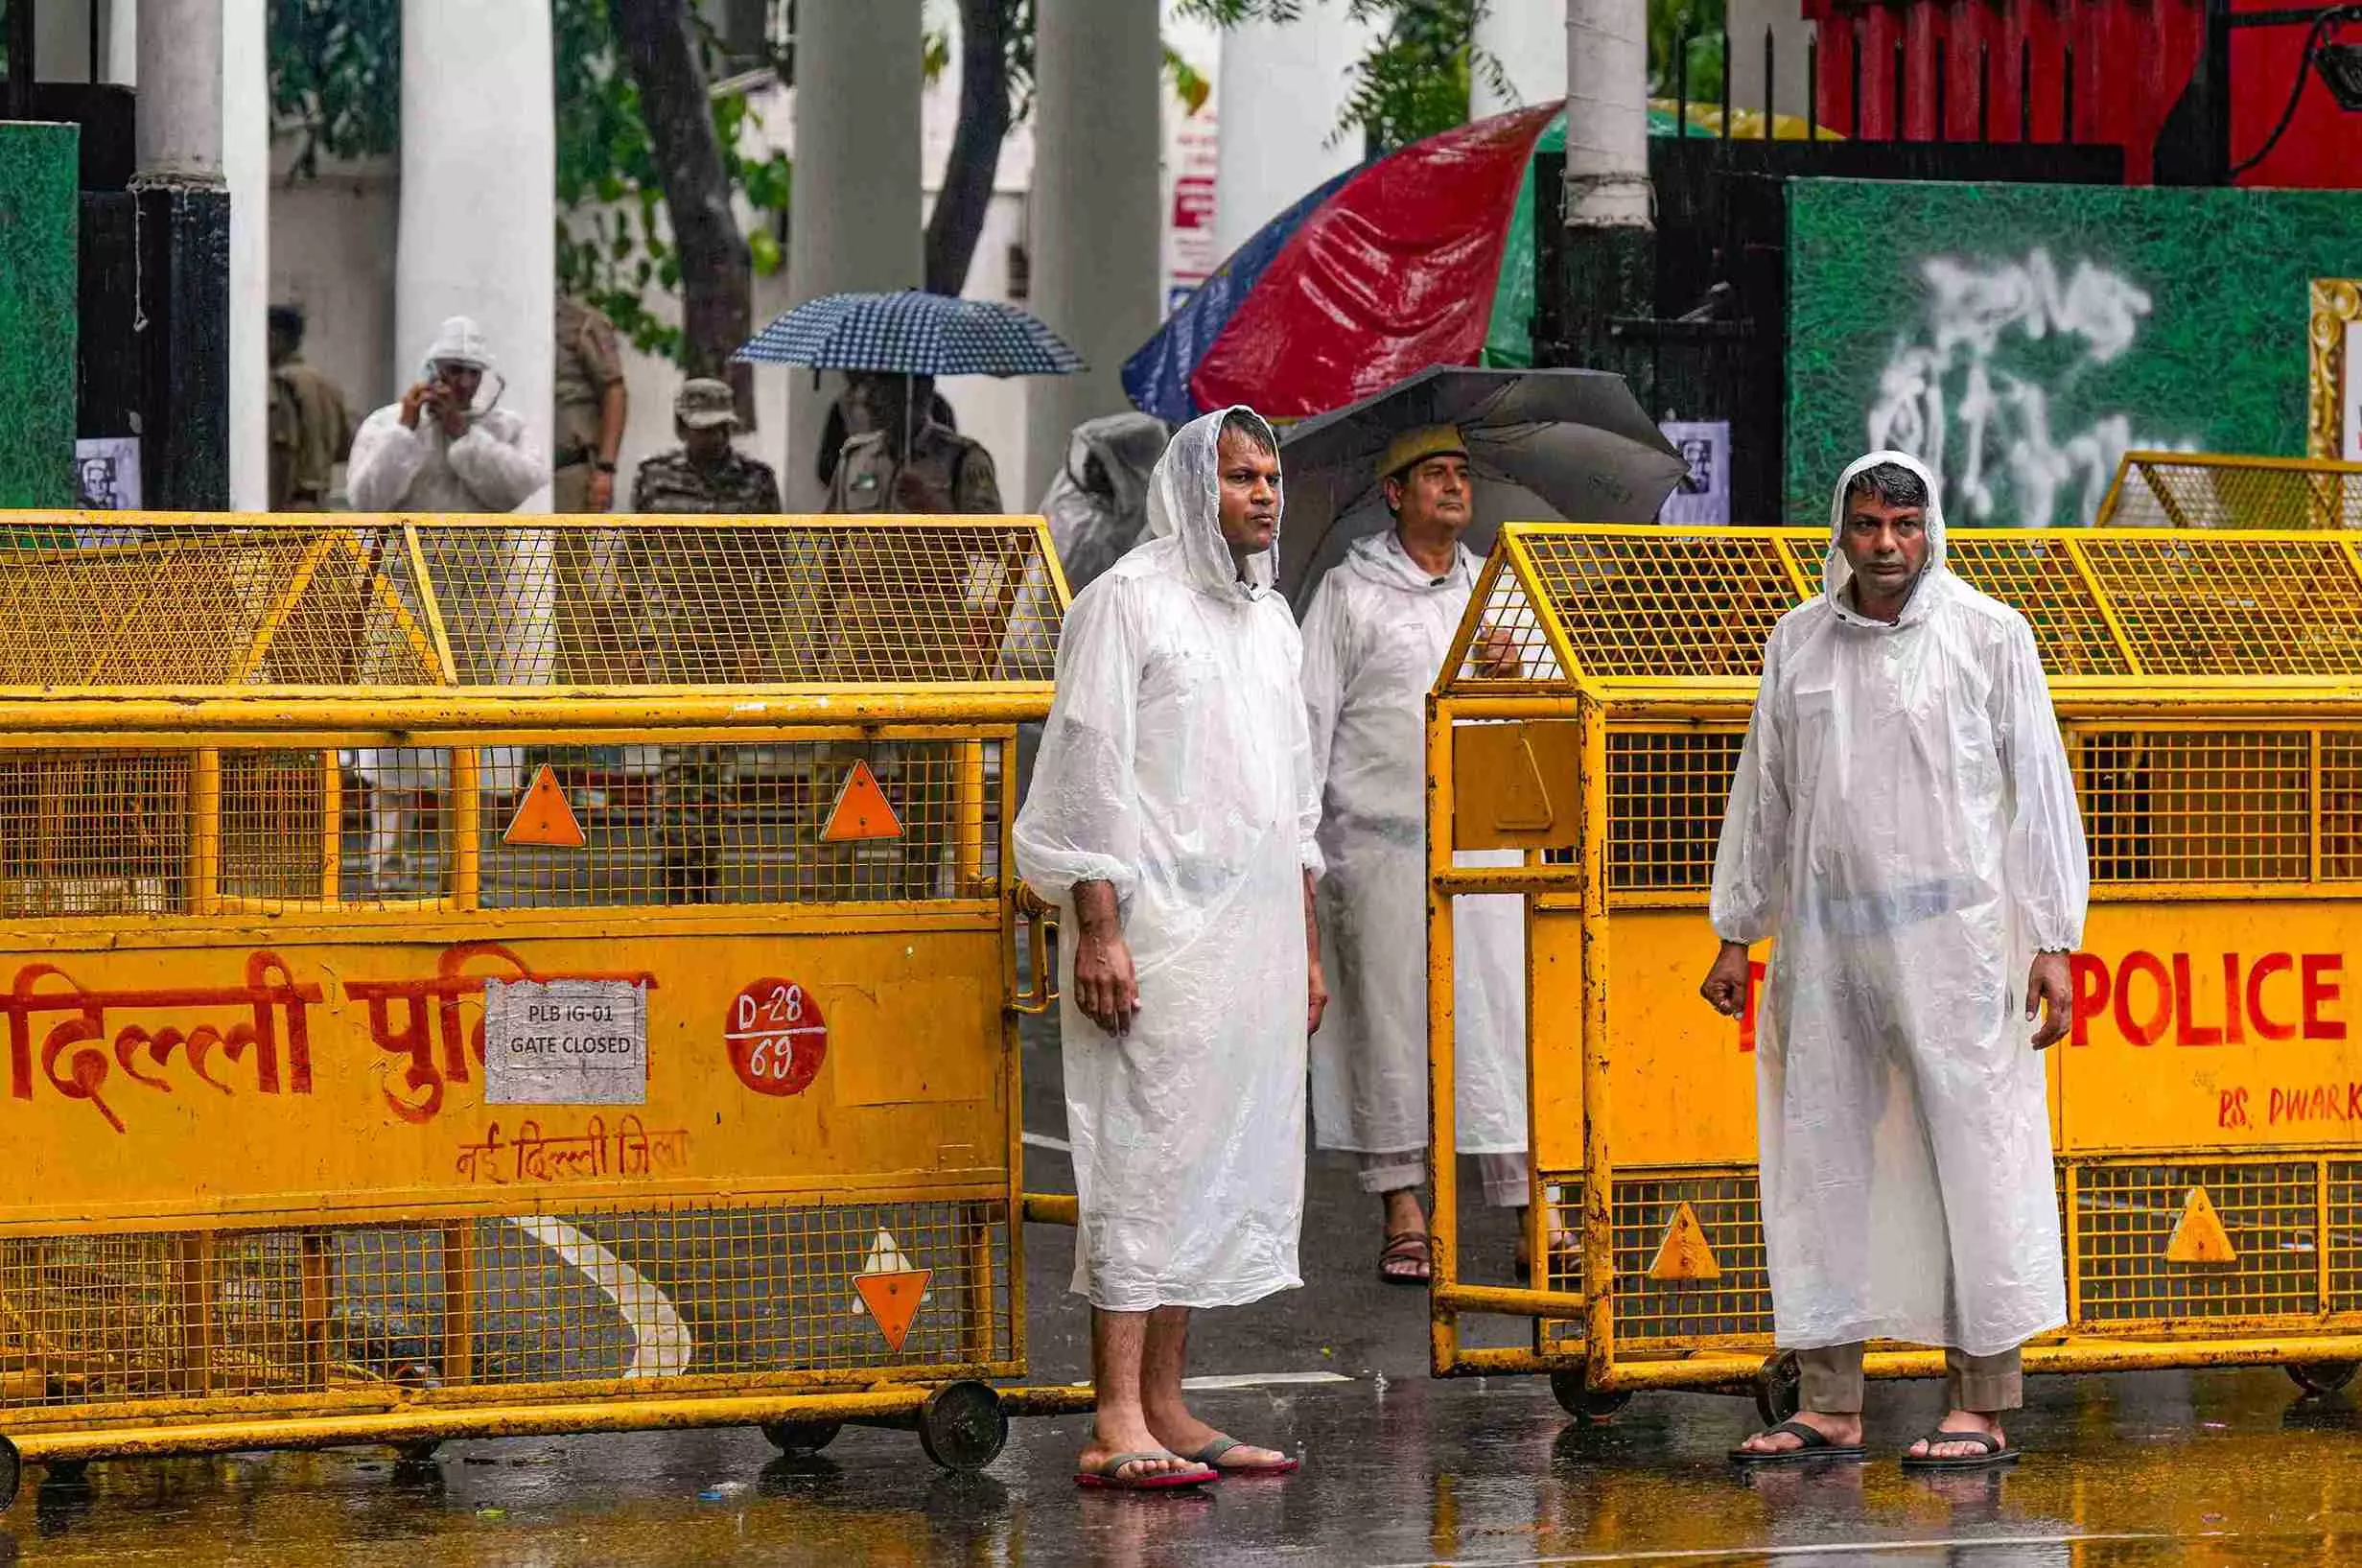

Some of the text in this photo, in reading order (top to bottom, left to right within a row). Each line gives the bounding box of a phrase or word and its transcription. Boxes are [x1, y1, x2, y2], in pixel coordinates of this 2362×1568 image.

[528, 1005, 614, 1022] PLB IG-01
[738, 984, 803, 1030] D-28
[2071, 950, 2347, 1047] POLICE
[0, 950, 323, 1134] दिल्ली
[510, 1037, 631, 1054] GATE CLOSED
[751, 1036, 793, 1080] 69
[2269, 1082, 2362, 1126] DWARK
[456, 1120, 508, 1184] नई
[510, 1113, 609, 1182] दिल्ली
